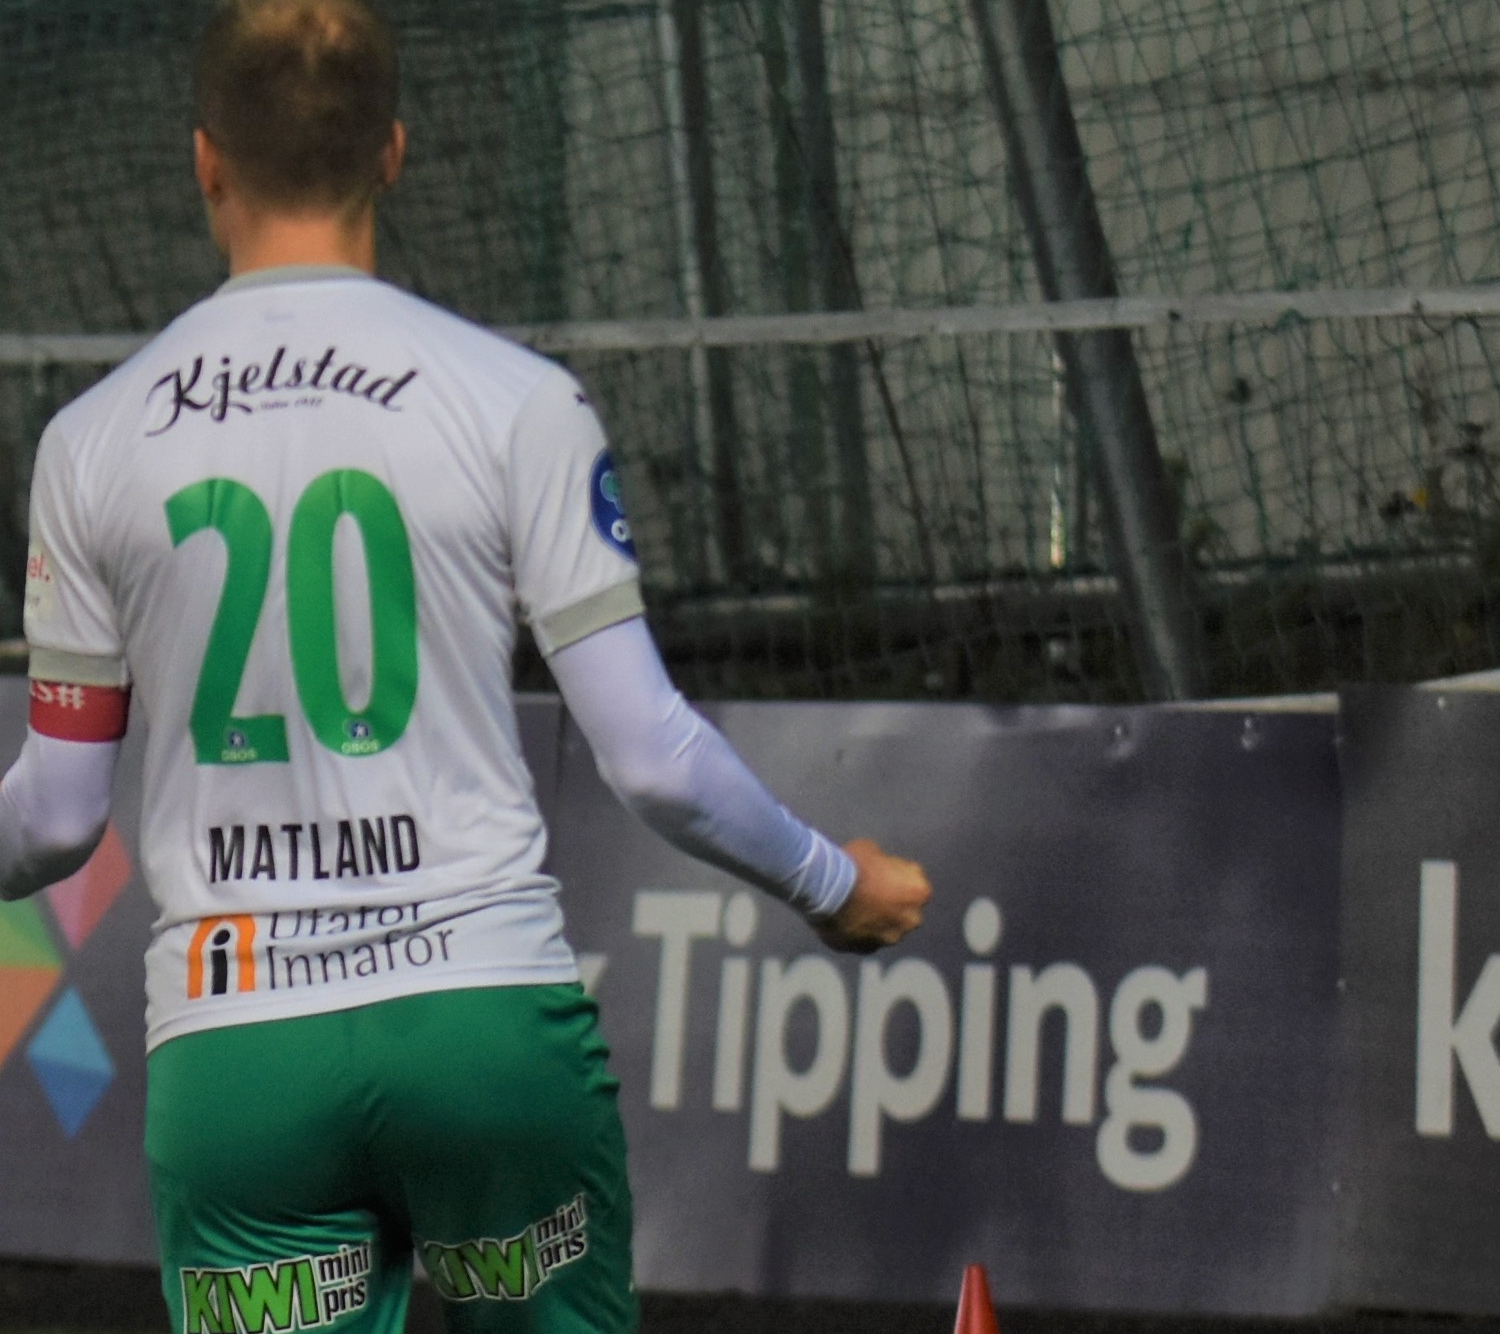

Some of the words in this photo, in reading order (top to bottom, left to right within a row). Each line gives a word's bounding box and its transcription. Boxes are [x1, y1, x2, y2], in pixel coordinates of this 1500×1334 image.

[145, 346, 419, 438] Kjelstad
[164, 468, 419, 765] 20
[208, 813, 422, 885] MATLAND
[265, 926, 455, 991] Innafor
[632, 891, 1209, 1193] Tipping
[536, 1192, 587, 1245] mini
[319, 1241, 372, 1280] mini
[424, 1225, 541, 1300] KIWI
[540, 1230, 587, 1277] pris
[321, 1283, 367, 1323] pris
